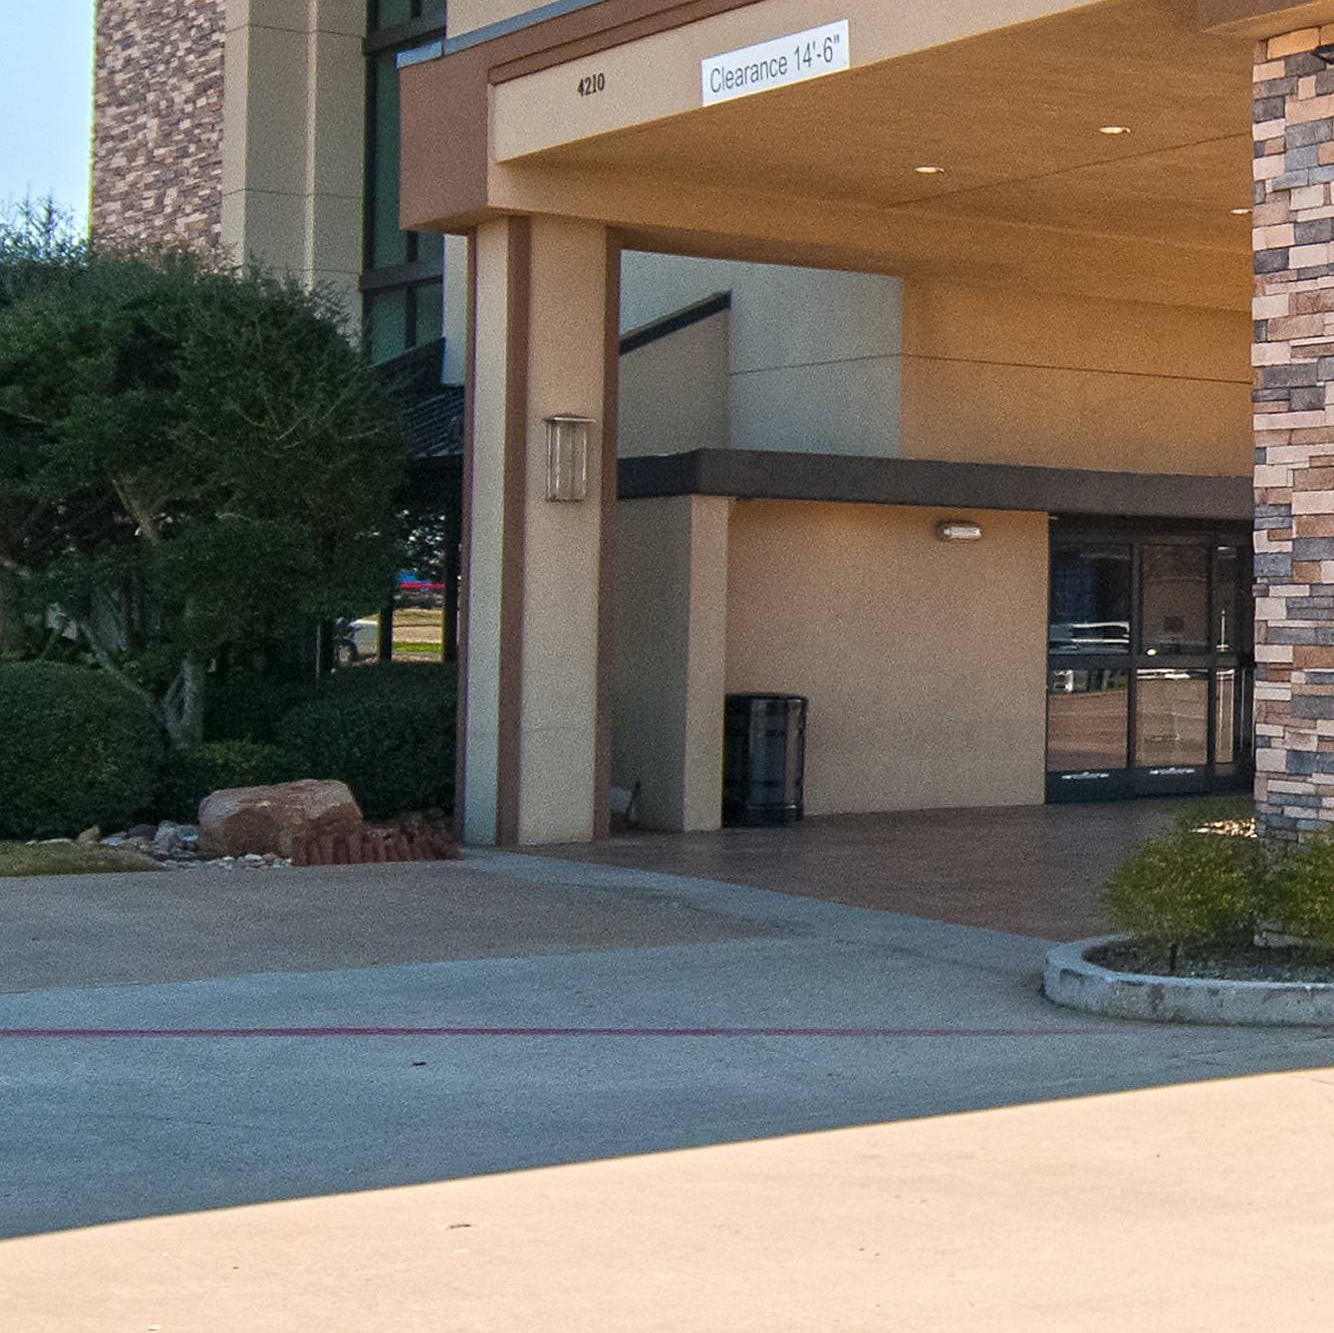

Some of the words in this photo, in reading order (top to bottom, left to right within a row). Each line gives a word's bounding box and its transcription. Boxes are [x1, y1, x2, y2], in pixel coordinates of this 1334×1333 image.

[577, 72, 605, 98] 4210
[710, 57, 788, 94] Clearance
[793, 33, 840, 71] 14'-6"
